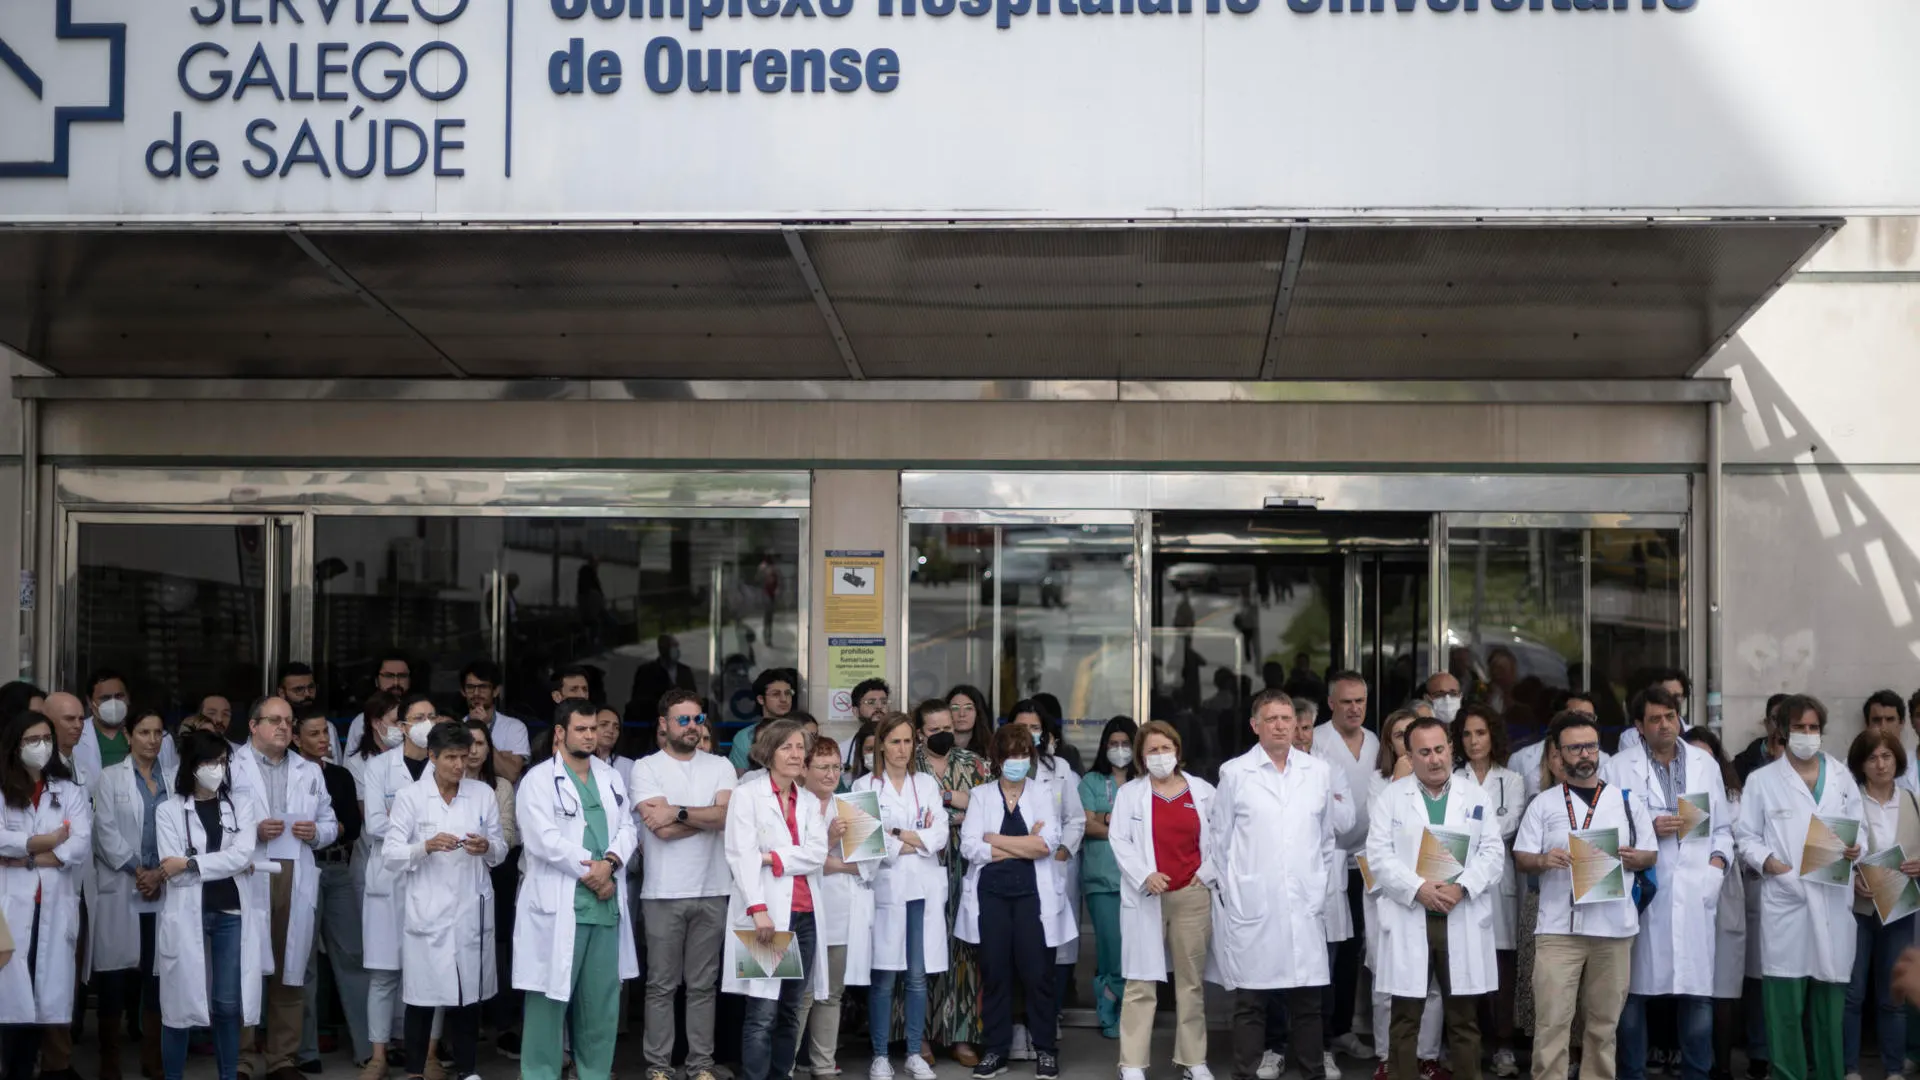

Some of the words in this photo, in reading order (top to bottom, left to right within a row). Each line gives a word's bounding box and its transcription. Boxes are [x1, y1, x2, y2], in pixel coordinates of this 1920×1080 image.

[178, 41, 468, 101] GALEGO
[548, 38, 622, 93] de
[644, 36, 900, 94] Ourense
[145, 112, 219, 178] de
[242, 106, 466, 178] SAÚDE
